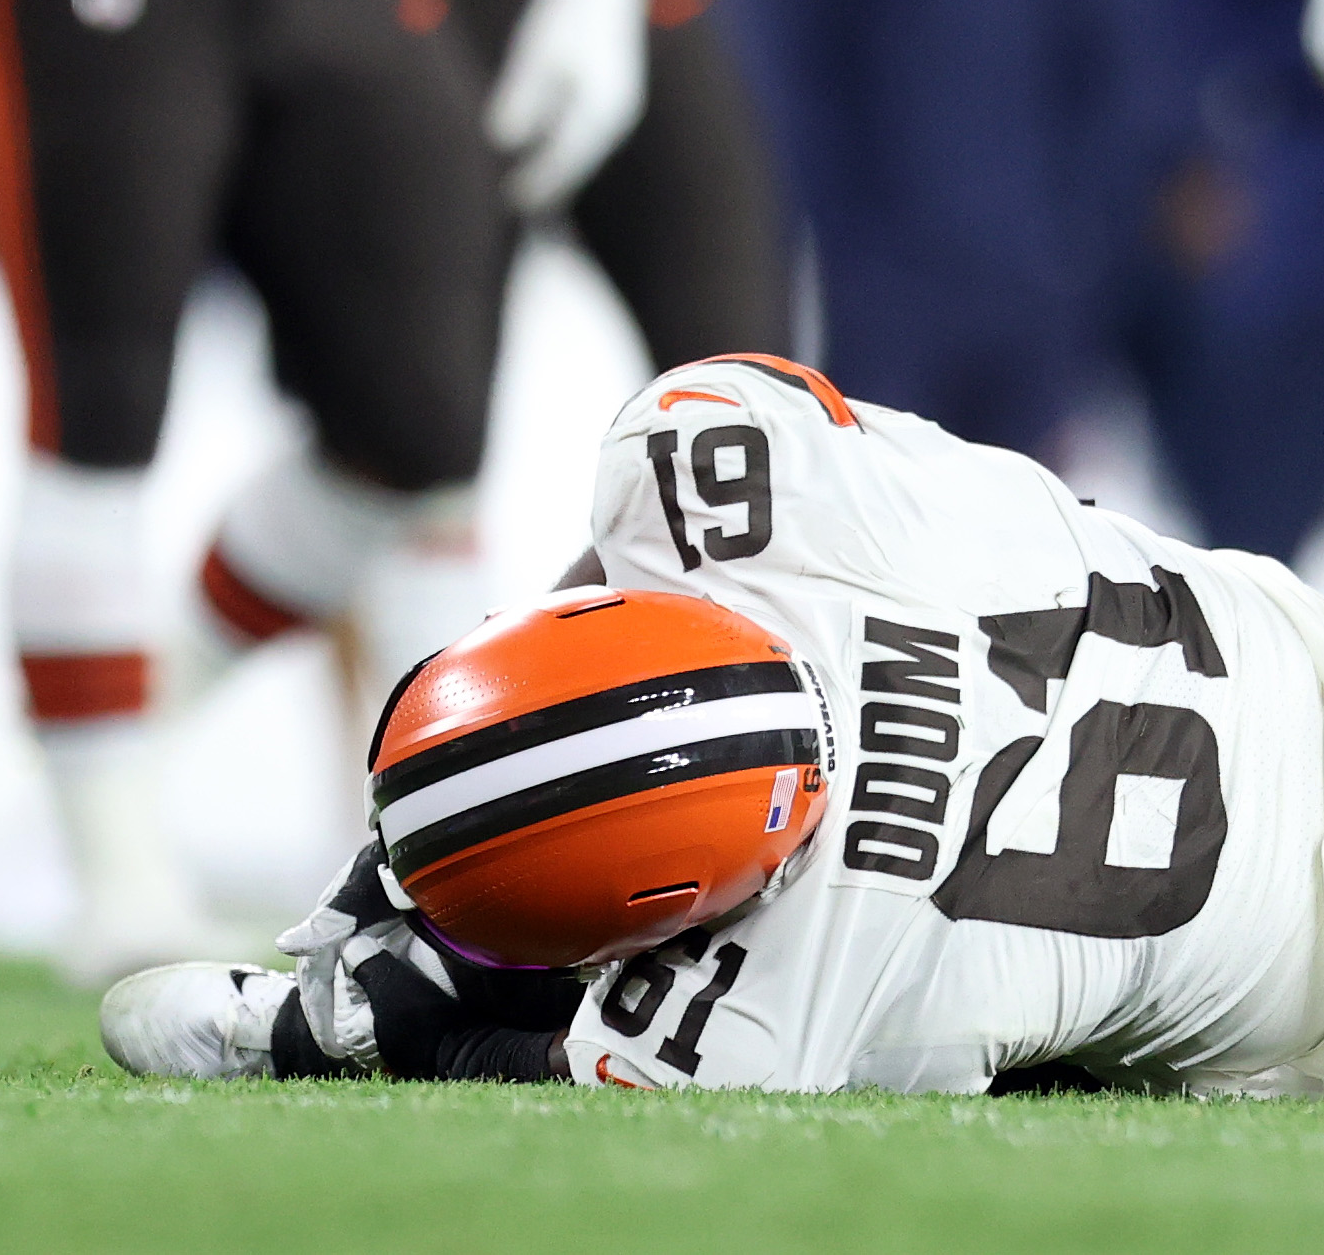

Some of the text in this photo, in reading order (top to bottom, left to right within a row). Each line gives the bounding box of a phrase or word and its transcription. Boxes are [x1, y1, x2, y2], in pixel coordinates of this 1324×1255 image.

[843, 615, 963, 882] ODOM
[933, 561, 1229, 940] 61
[600, 924, 749, 1079] 61
